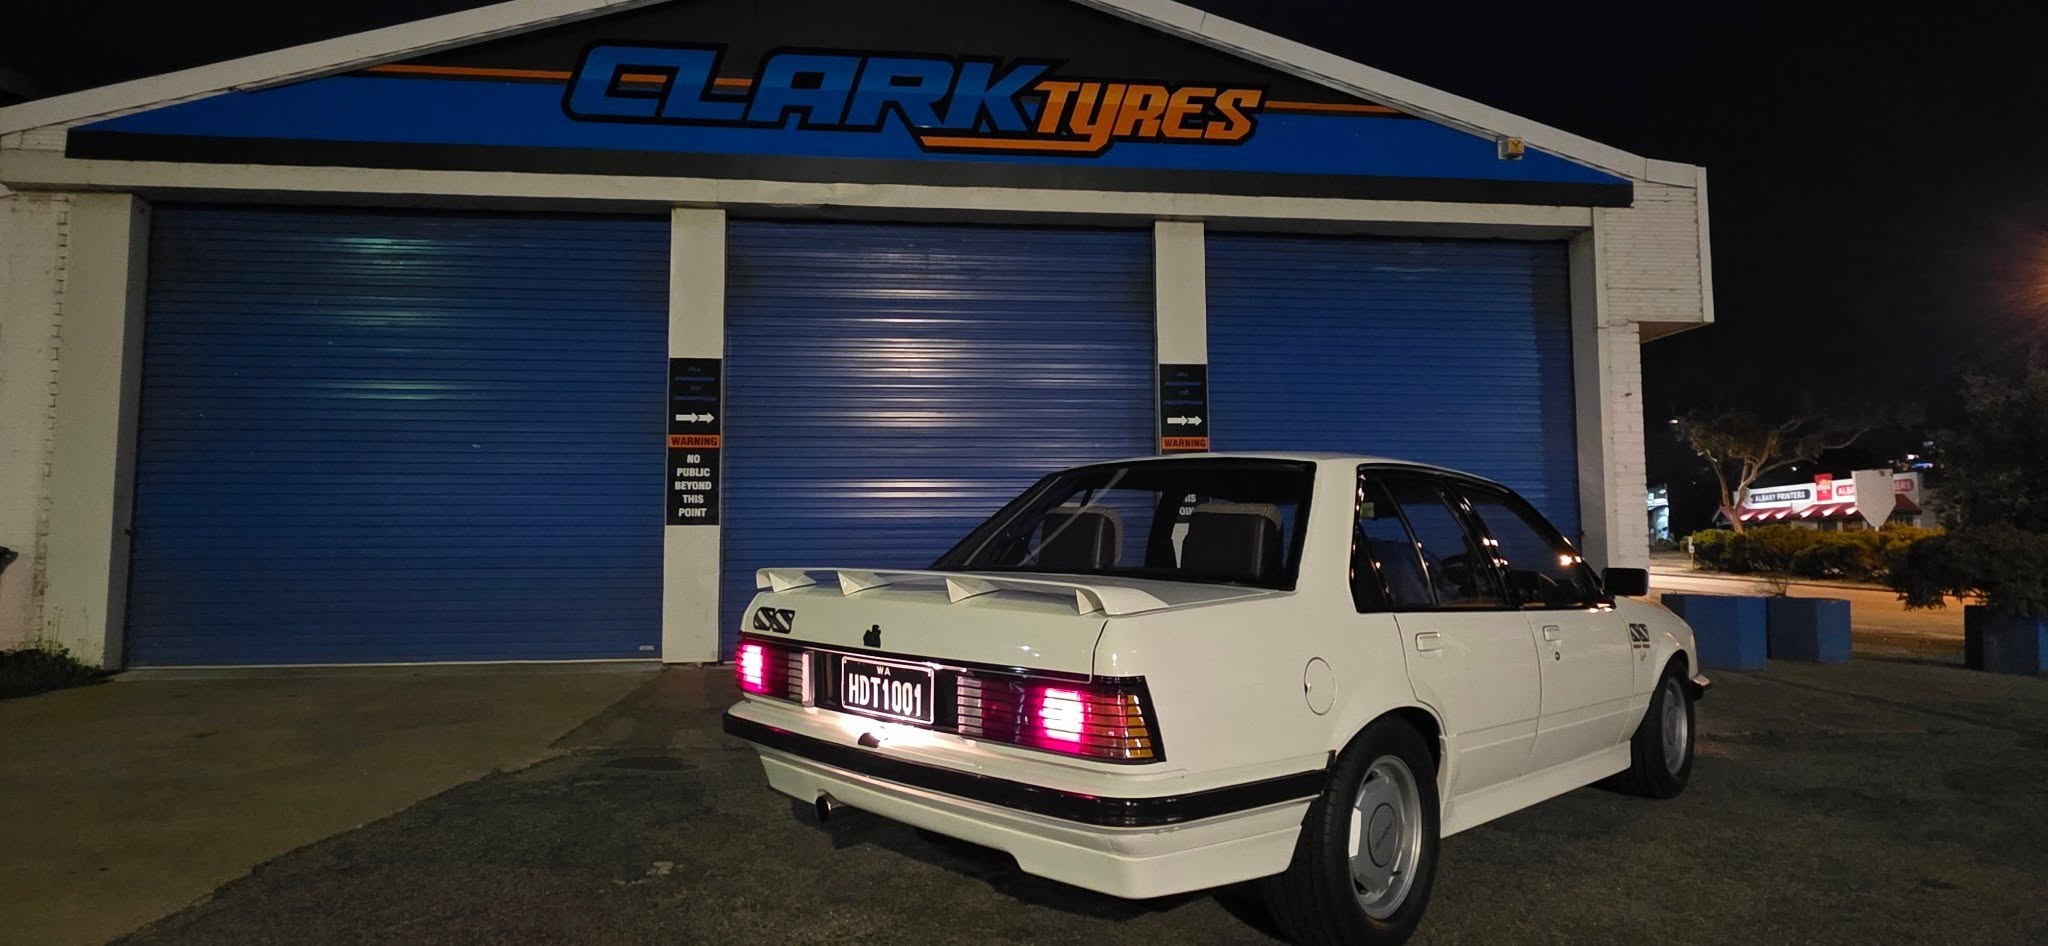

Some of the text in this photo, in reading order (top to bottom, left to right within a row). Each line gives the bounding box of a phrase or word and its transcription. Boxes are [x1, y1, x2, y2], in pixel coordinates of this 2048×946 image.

[575, 48, 1264, 150] CLARK TYRES
[670, 435, 718, 447] WARNING
[1163, 437, 1207, 448] WARNING
[686, 454, 701, 464] NO
[676, 467, 711, 477] PUBLIC
[674, 480, 712, 491] BEYOND
[682, 494, 704, 504] THIS
[1755, 491, 1806, 502] ALBANY PRINTERS
[678, 507, 707, 518] POINT
[876, 665, 891, 676] WA
[847, 672, 923, 717] HDT1001
